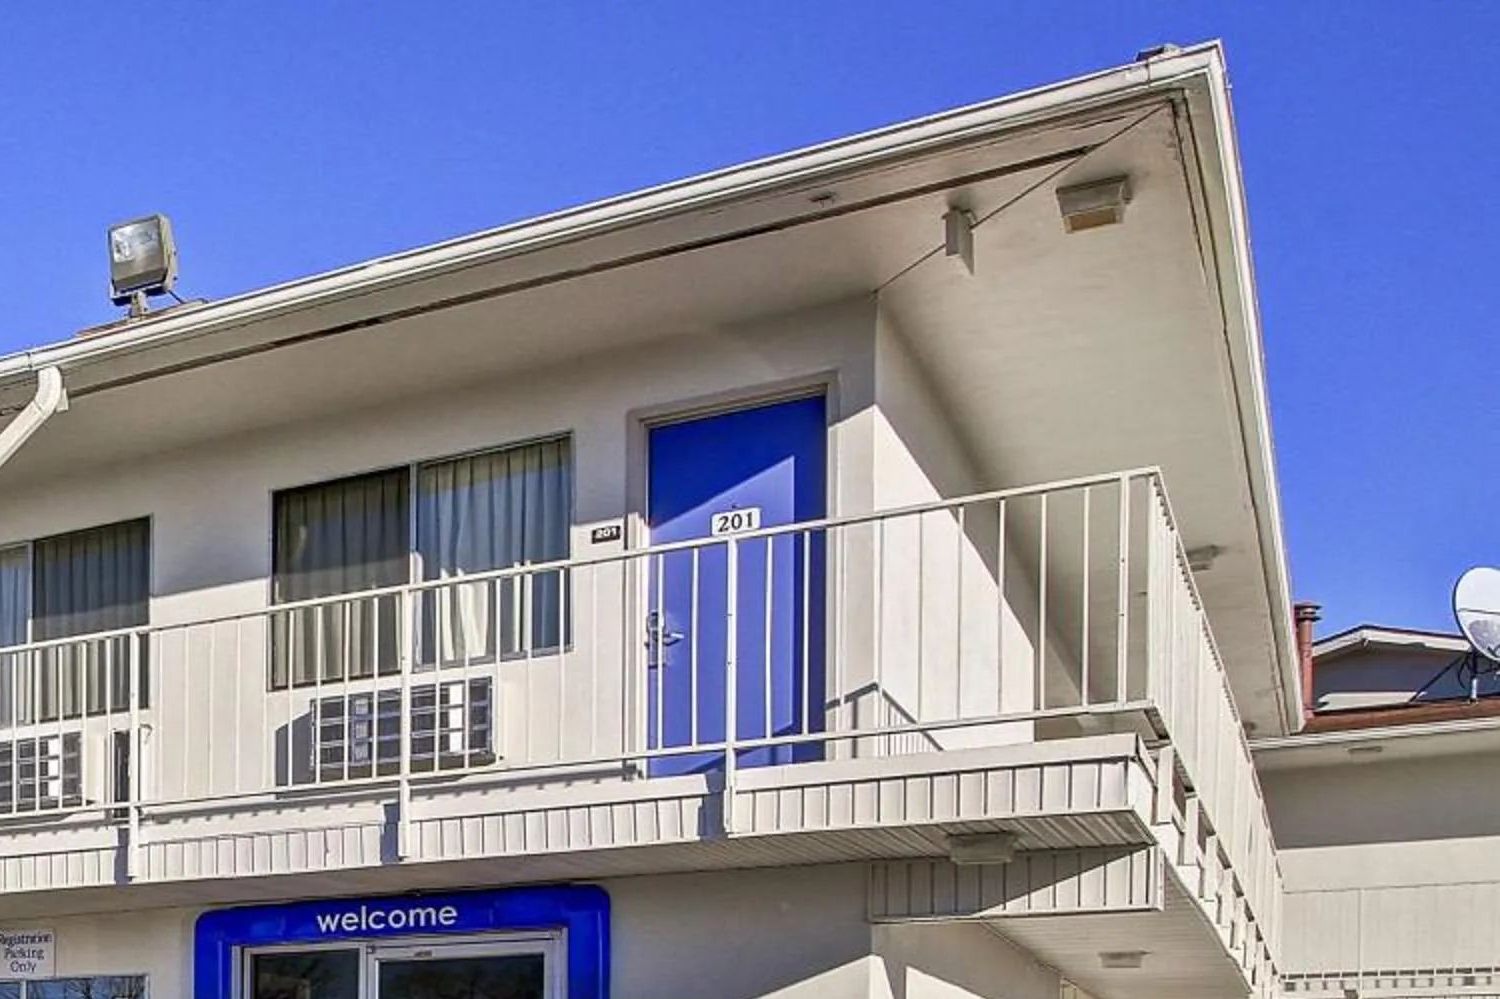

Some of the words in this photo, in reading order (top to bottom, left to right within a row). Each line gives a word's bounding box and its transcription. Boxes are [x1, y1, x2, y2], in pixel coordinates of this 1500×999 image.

[718, 511, 754, 533] 201
[316, 905, 457, 932] welcome
[4, 947, 45, 960] Parking
[10, 960, 37, 973] Only
